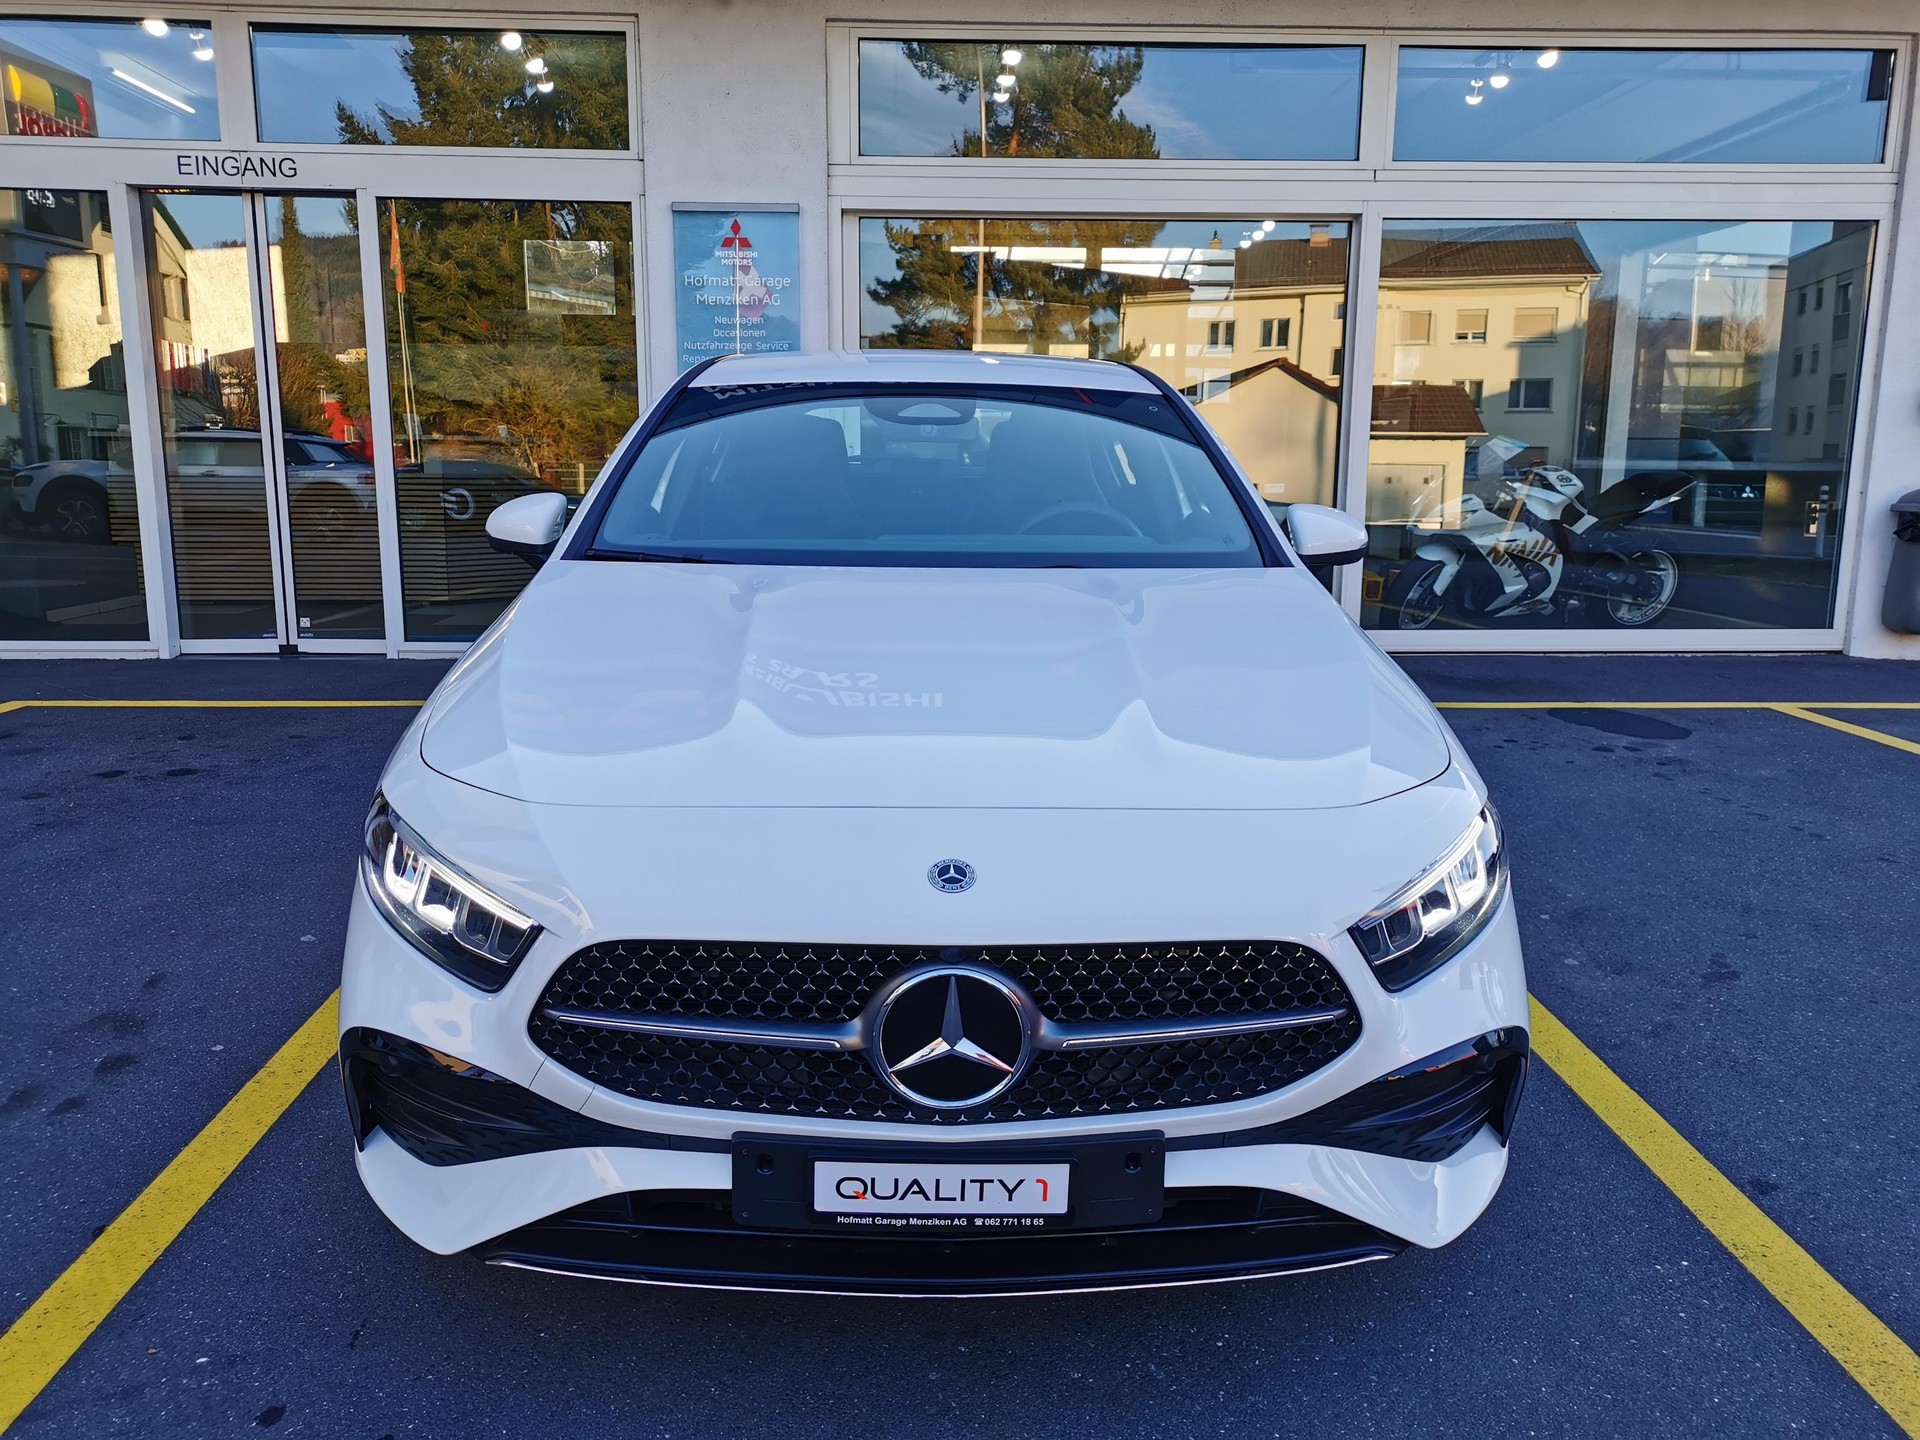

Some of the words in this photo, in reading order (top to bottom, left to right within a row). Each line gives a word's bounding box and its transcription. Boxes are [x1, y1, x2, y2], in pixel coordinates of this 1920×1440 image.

[177, 155, 298, 178] EINGANG
[715, 250, 758, 258] MITSUBISHI
[721, 258, 753, 266] MOTORS
[744, 275, 791, 289] Garage
[762, 294, 781, 306] AG
[755, 341, 789, 351] Service
[835, 1176, 1026, 1202] QUALITY
[1035, 1178, 1049, 1202] 1
[837, 1215, 873, 1225] Hofmatt
[874, 1217, 907, 1227] Garage
[909, 1217, 951, 1226] Menziken
[952, 1217, 968, 1226] AG
[984, 1218, 1001, 1226] 062
[1002, 1218, 1018, 1226] 771
[1020, 1218, 1032, 1226] 18
[1033, 1218, 1045, 1226] 65
